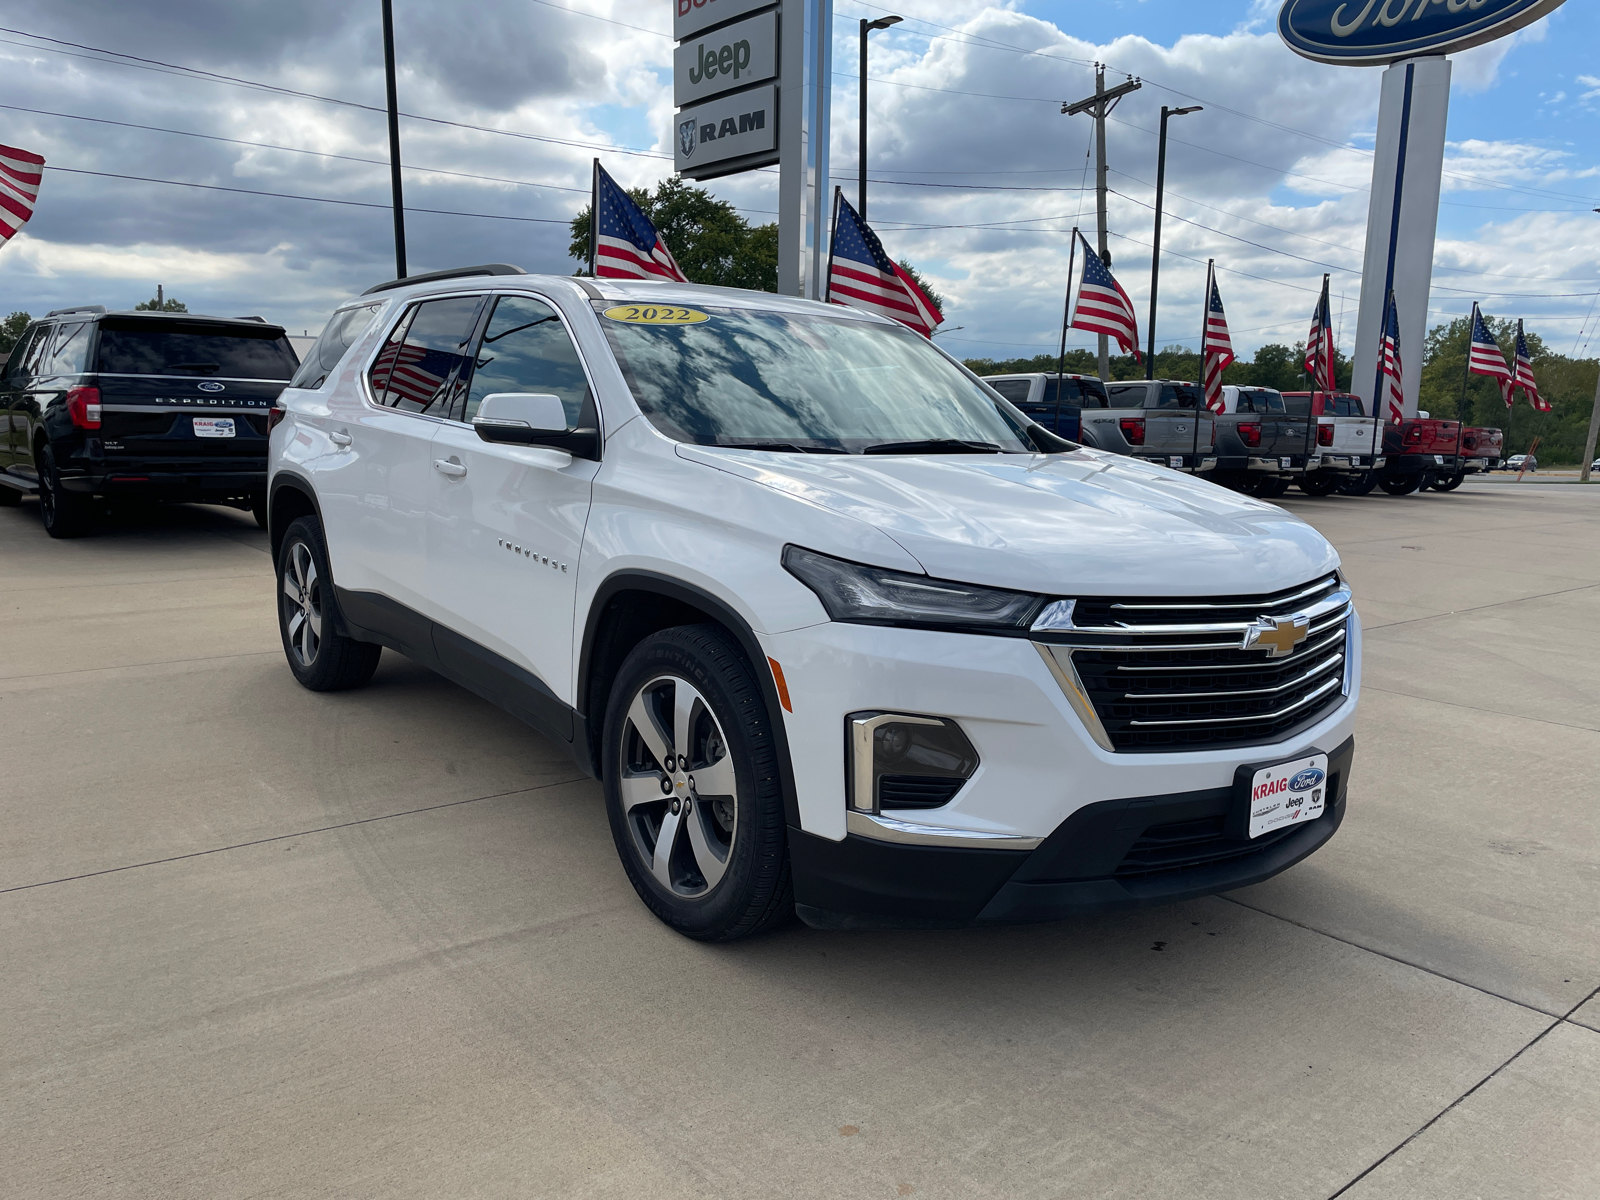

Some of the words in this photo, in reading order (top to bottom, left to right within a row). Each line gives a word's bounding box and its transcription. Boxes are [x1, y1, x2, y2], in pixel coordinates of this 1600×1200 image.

[689, 39, 750, 84] Jeep
[700, 110, 765, 143] RAM
[625, 308, 691, 320] 2022
[155, 397, 267, 406] EXPEDITION
[498, 537, 568, 573] TRAVERSE
[1252, 777, 1288, 802] KRAIG
[1285, 796, 1304, 809] Jeep
